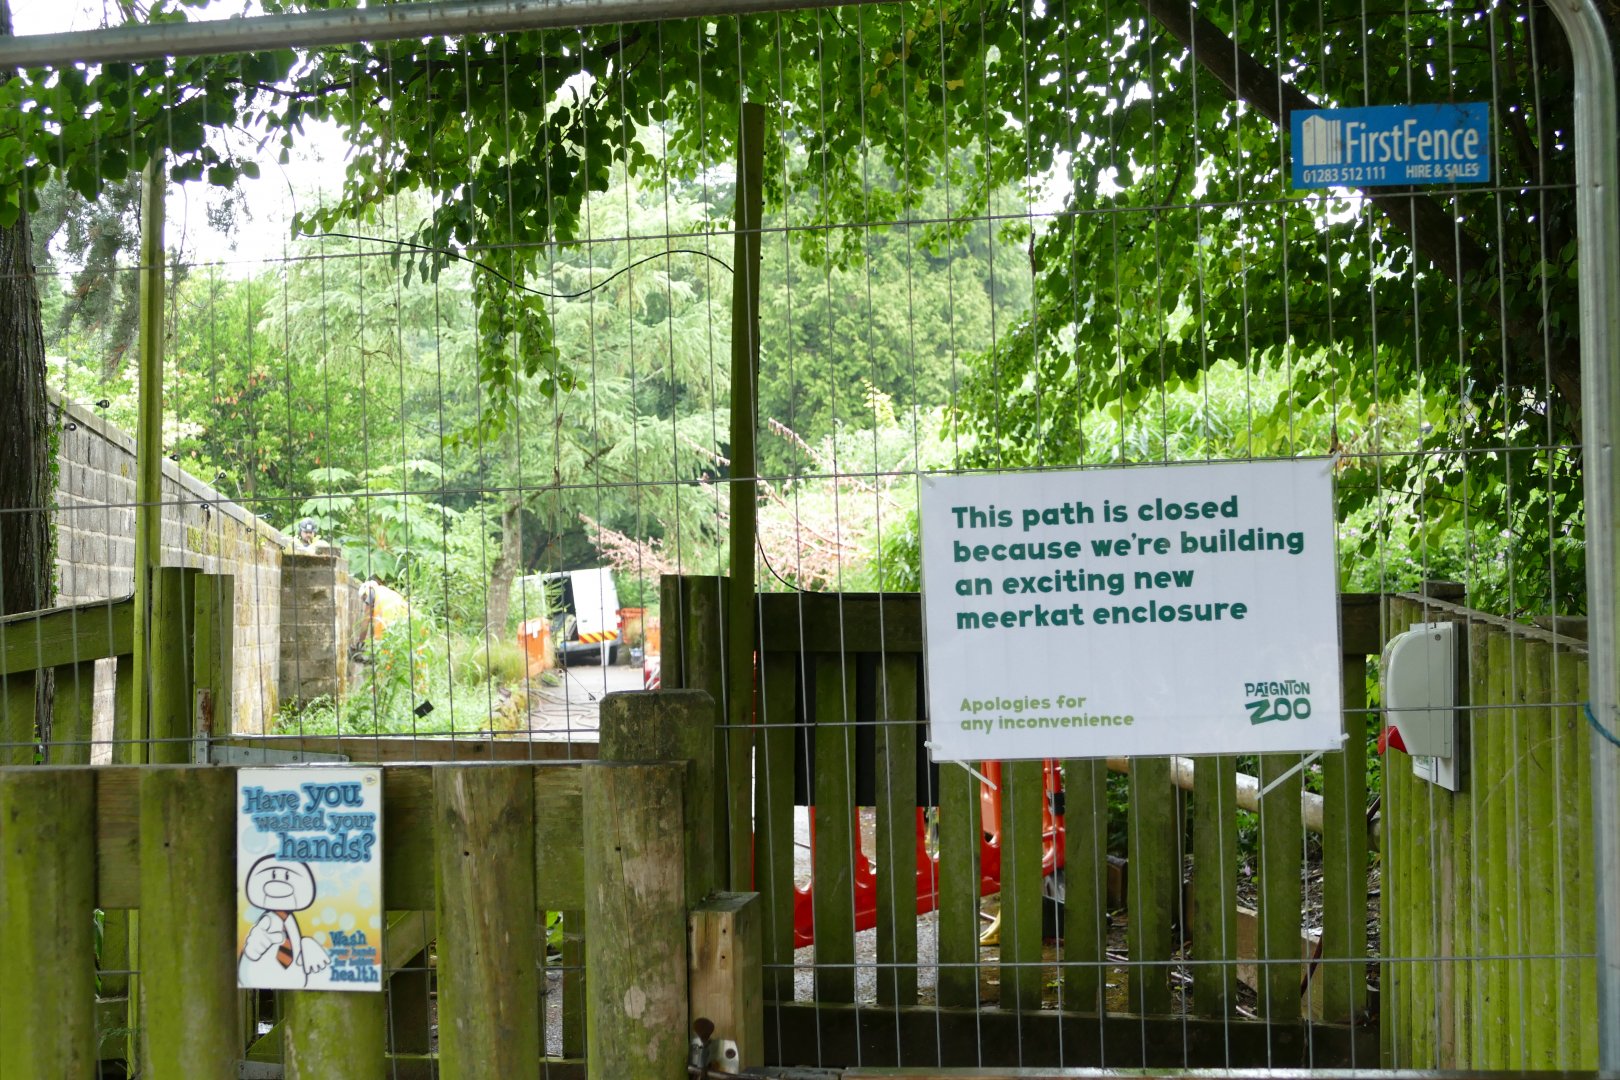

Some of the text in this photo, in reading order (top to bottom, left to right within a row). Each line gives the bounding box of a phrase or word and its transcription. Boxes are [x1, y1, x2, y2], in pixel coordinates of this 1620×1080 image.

[1346, 119, 1479, 163] FirstFence
[1303, 167, 1385, 183] 01283 512 111
[1406, 163, 1479, 178] HIRE & SALES
[951, 495, 1239, 532] This path is closed
[953, 527, 1305, 563] because we're building
[955, 568, 1194, 596] an exciting new
[956, 600, 1248, 629] meerkat enclosure
[960, 694, 1086, 714] Apologies for
[1245, 698, 1311, 725] ZOO
[960, 713, 1134, 734] any inconvenience
[243, 784, 362, 813] Have you
[253, 811, 375, 833] washed your
[278, 832, 375, 861] hands?
[329, 930, 367, 946] Wash
[329, 966, 379, 982] health
